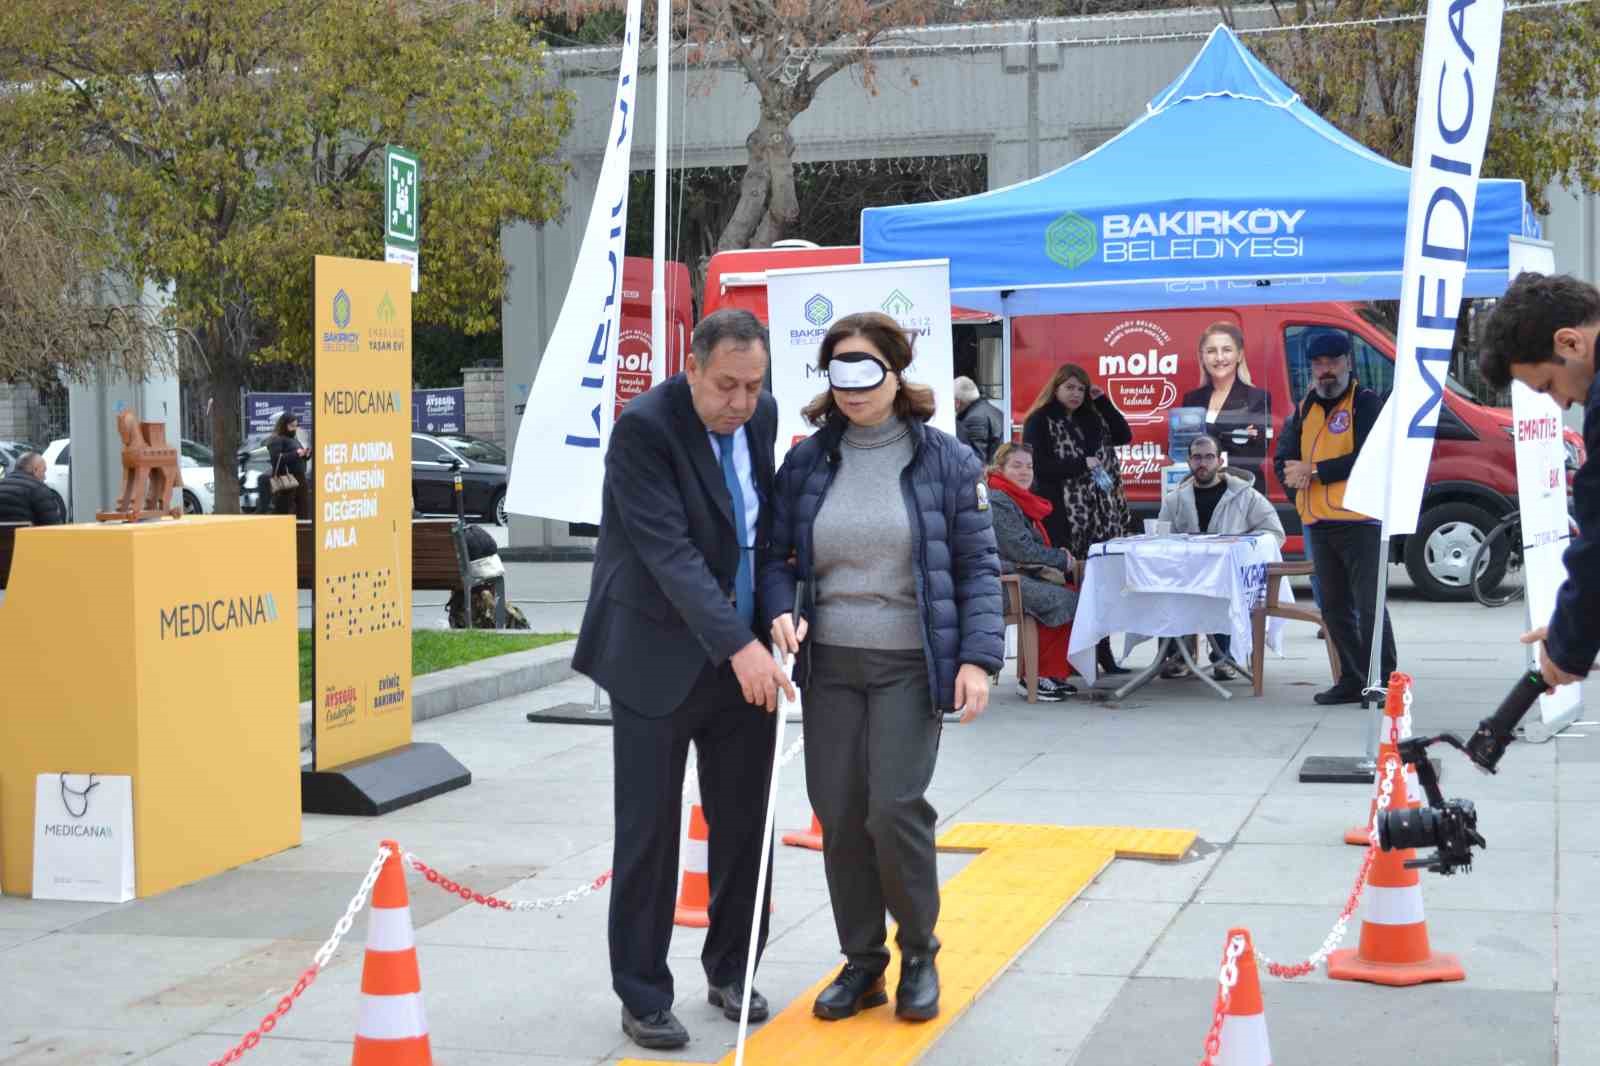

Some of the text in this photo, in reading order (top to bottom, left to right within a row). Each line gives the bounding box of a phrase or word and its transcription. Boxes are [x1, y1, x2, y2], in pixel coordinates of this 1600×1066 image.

[1102, 208, 1306, 239] BAKIRKÖY
[790, 328, 829, 338] BAKIR
[1099, 349, 1178, 376] mola
[324, 391, 395, 415] MEDICANA
[324, 441, 394, 465] HER ADIMDA
[324, 464, 384, 493] GÖRMENİN
[324, 492, 378, 522] DEĞERİNİ
[324, 527, 358, 549] ANLA
[160, 594, 266, 640] MEDICANA
[44, 824, 106, 838] MEDICANA
